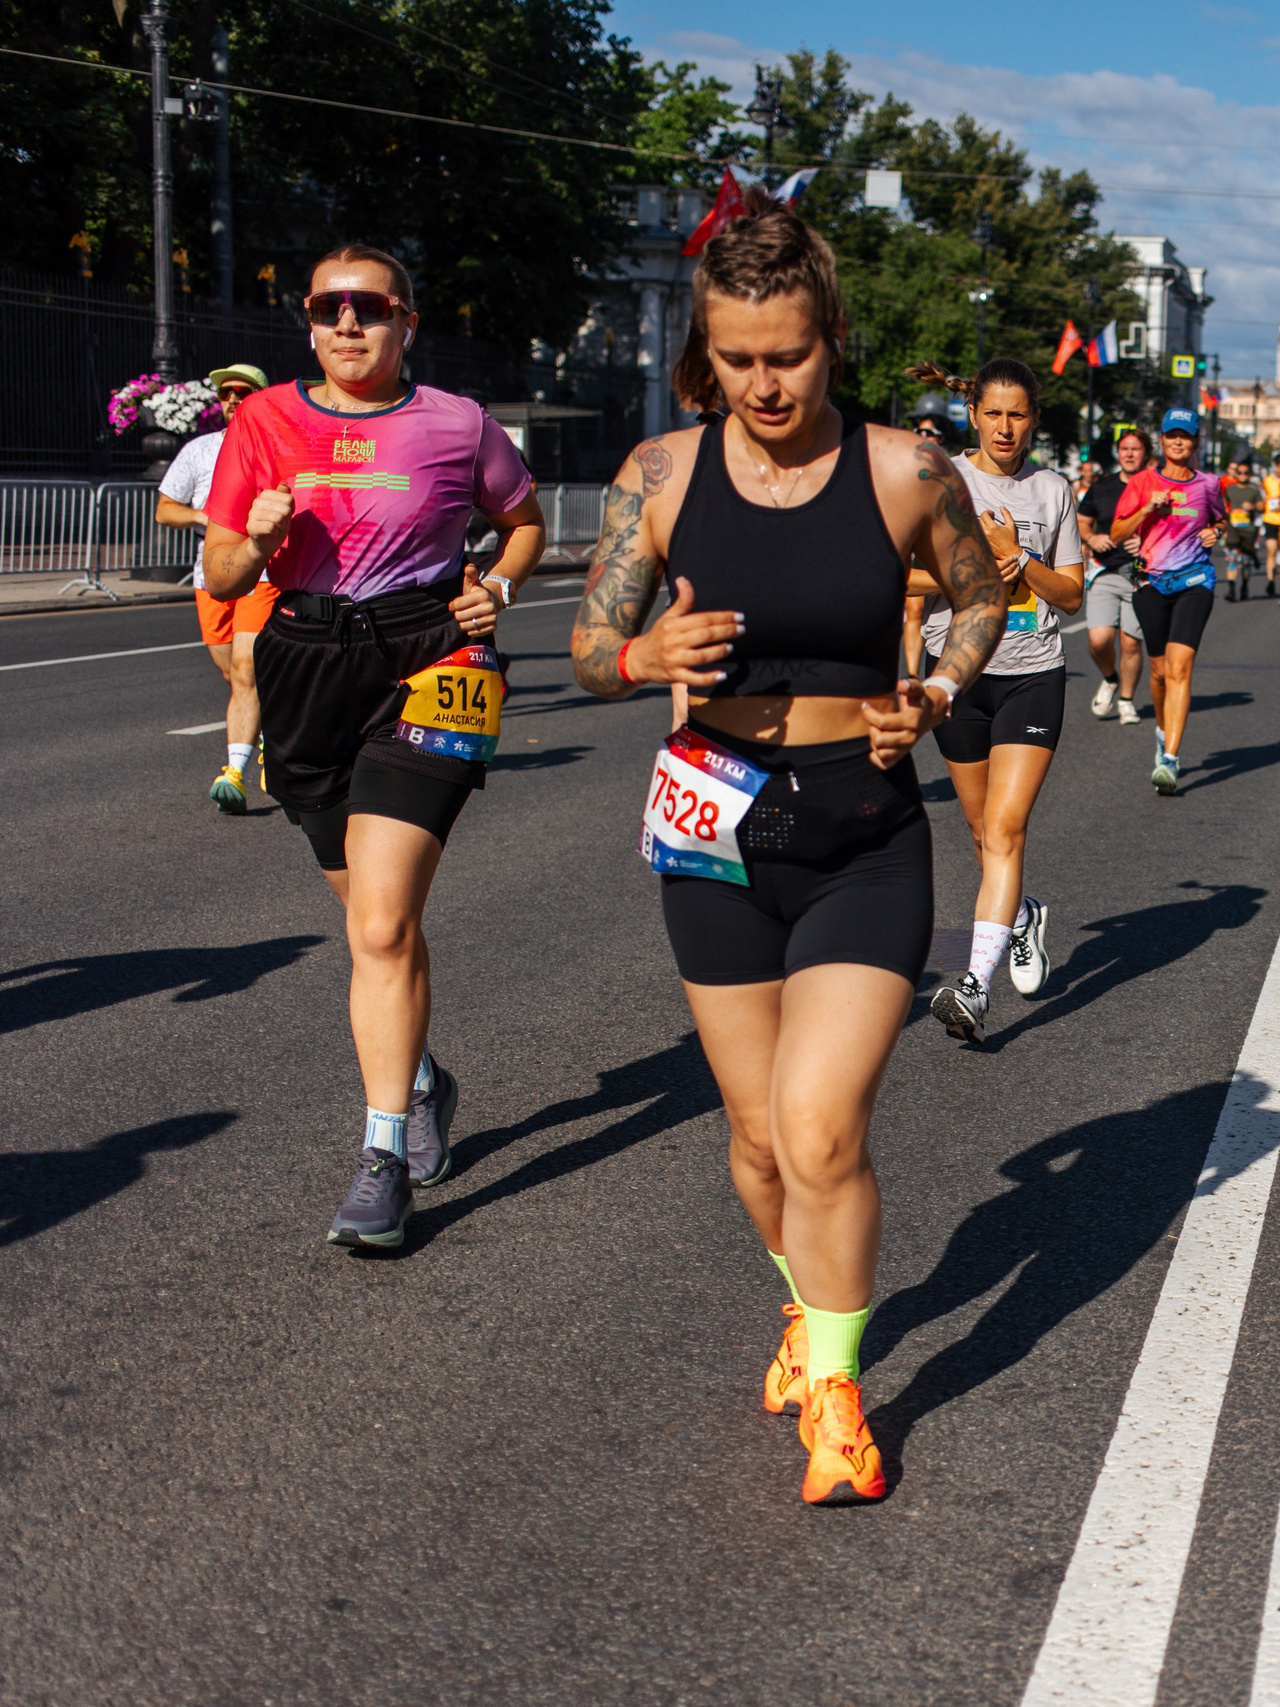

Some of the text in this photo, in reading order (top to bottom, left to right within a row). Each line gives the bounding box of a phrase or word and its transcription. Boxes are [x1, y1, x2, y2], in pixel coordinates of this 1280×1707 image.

[334, 440, 376, 449] БЕЛЫЕ
[333, 448, 376, 457] НОЧИ
[469, 652, 484, 663] 21,1
[436, 674, 487, 713] 514
[433, 713, 486, 727] АНАСТАСИЯ
[703, 751, 725, 769] 21,1
[651, 768, 720, 842] 7528
